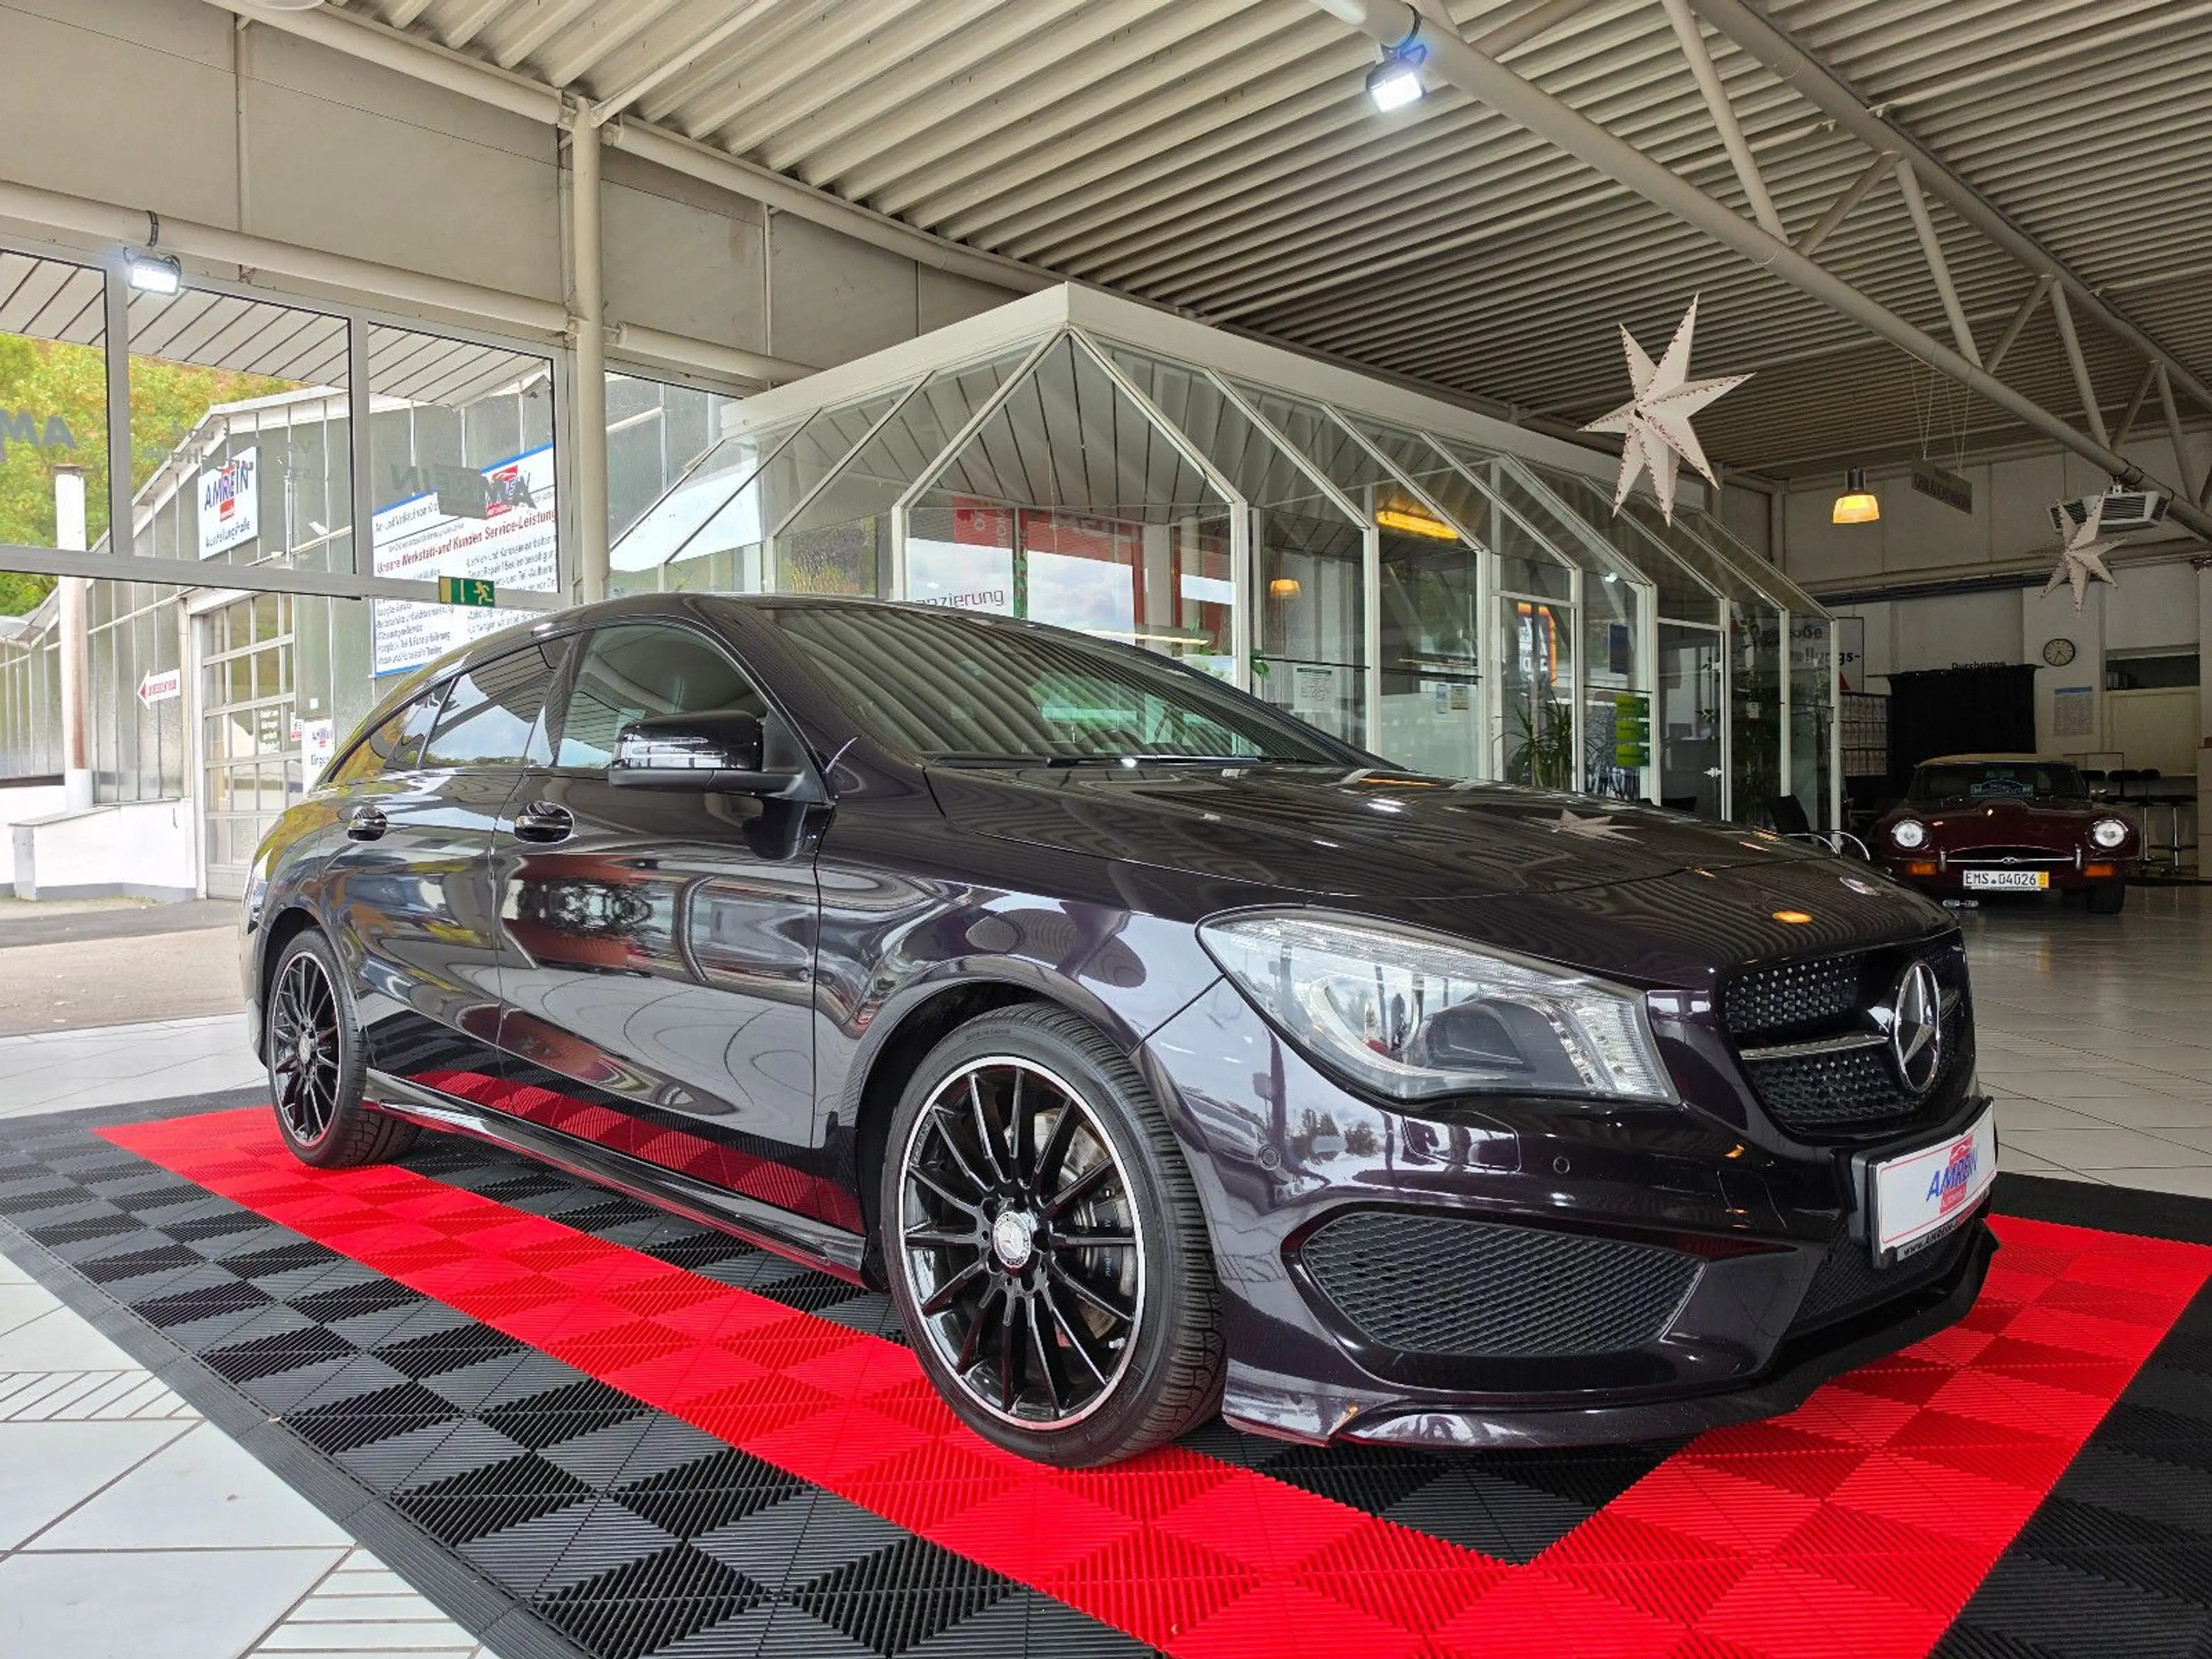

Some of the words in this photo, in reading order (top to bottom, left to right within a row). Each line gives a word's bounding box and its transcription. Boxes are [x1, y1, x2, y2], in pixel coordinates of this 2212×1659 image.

[204, 467, 249, 512] AMREIN
[453, 531, 483, 550] Kunden
[916, 589, 1005, 607] anzierung
[1965, 873, 1988, 885] EMS
[1998, 874, 2036, 885] 04026
[1925, 1143, 1979, 1203] AMREIN
